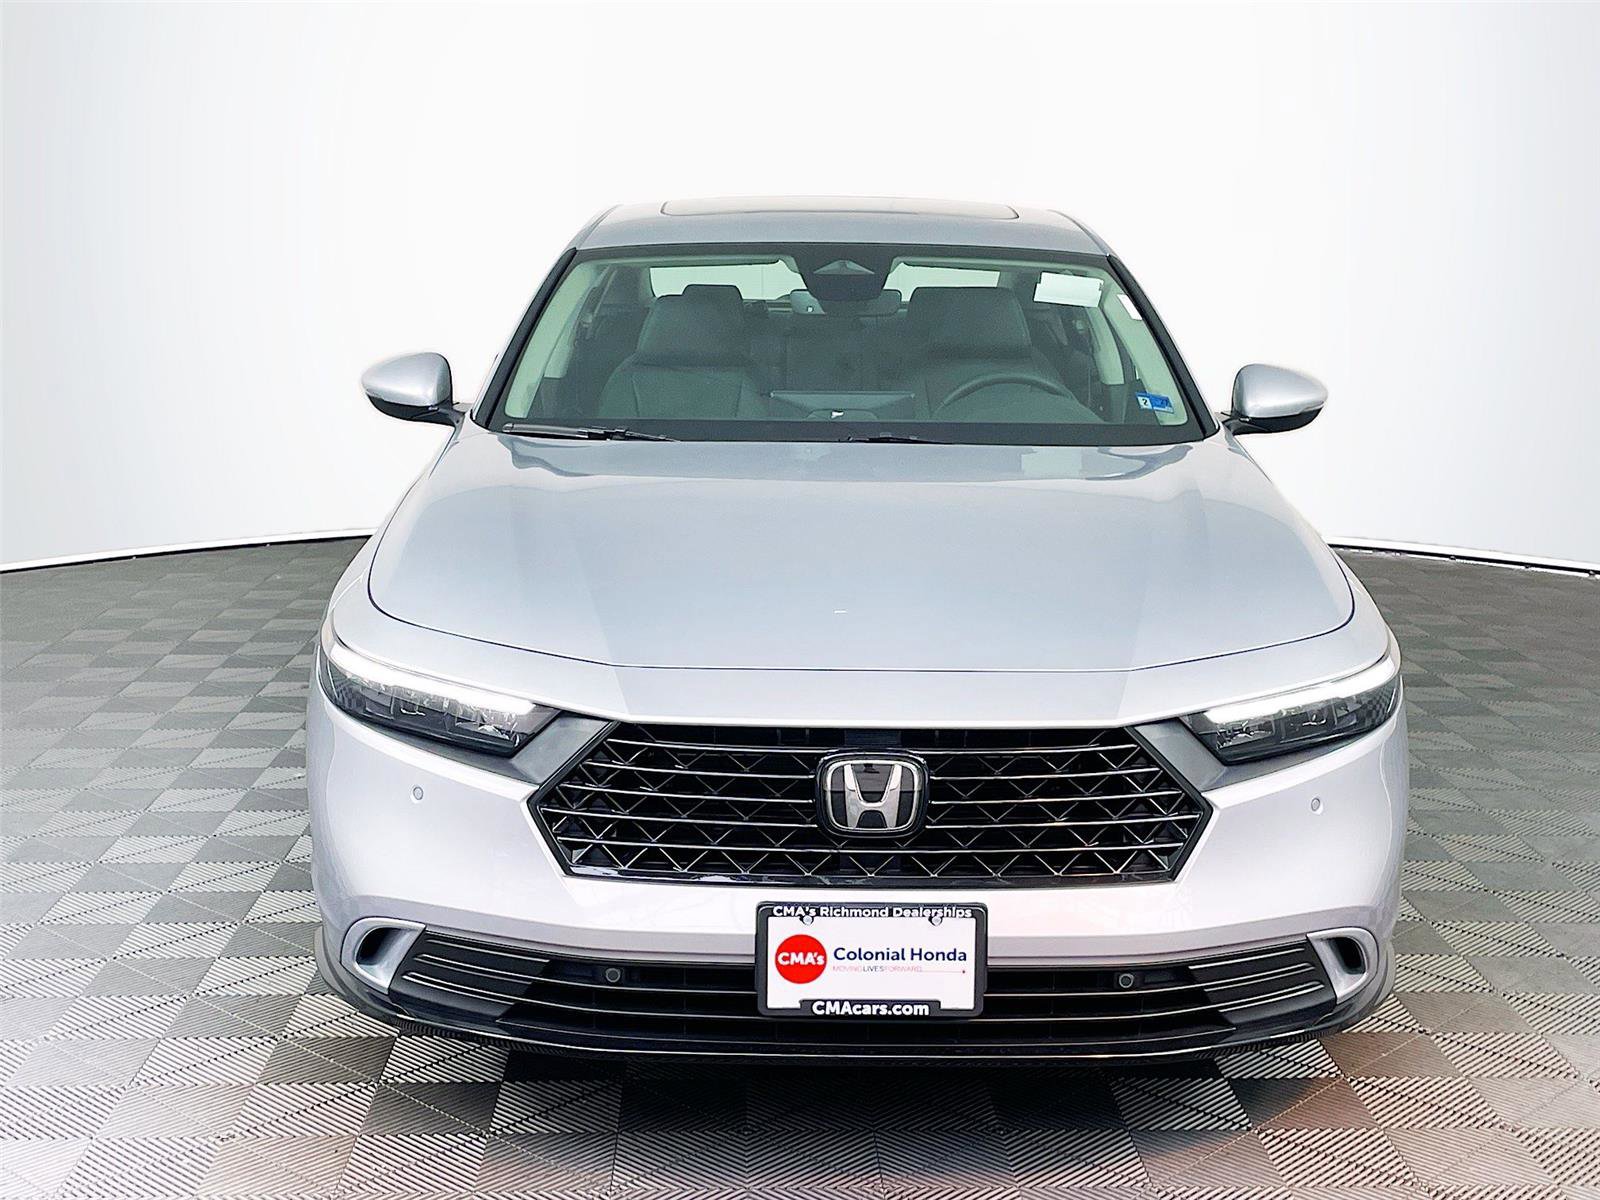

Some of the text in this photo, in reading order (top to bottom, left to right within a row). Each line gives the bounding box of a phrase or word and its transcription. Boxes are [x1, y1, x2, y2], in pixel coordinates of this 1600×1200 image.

[773, 905, 972, 918] CMA's Richmond Dealerships
[777, 952, 825, 965] CMA's
[833, 947, 967, 961] Colonial Honda
[812, 1001, 929, 1016] CMAcars.com
